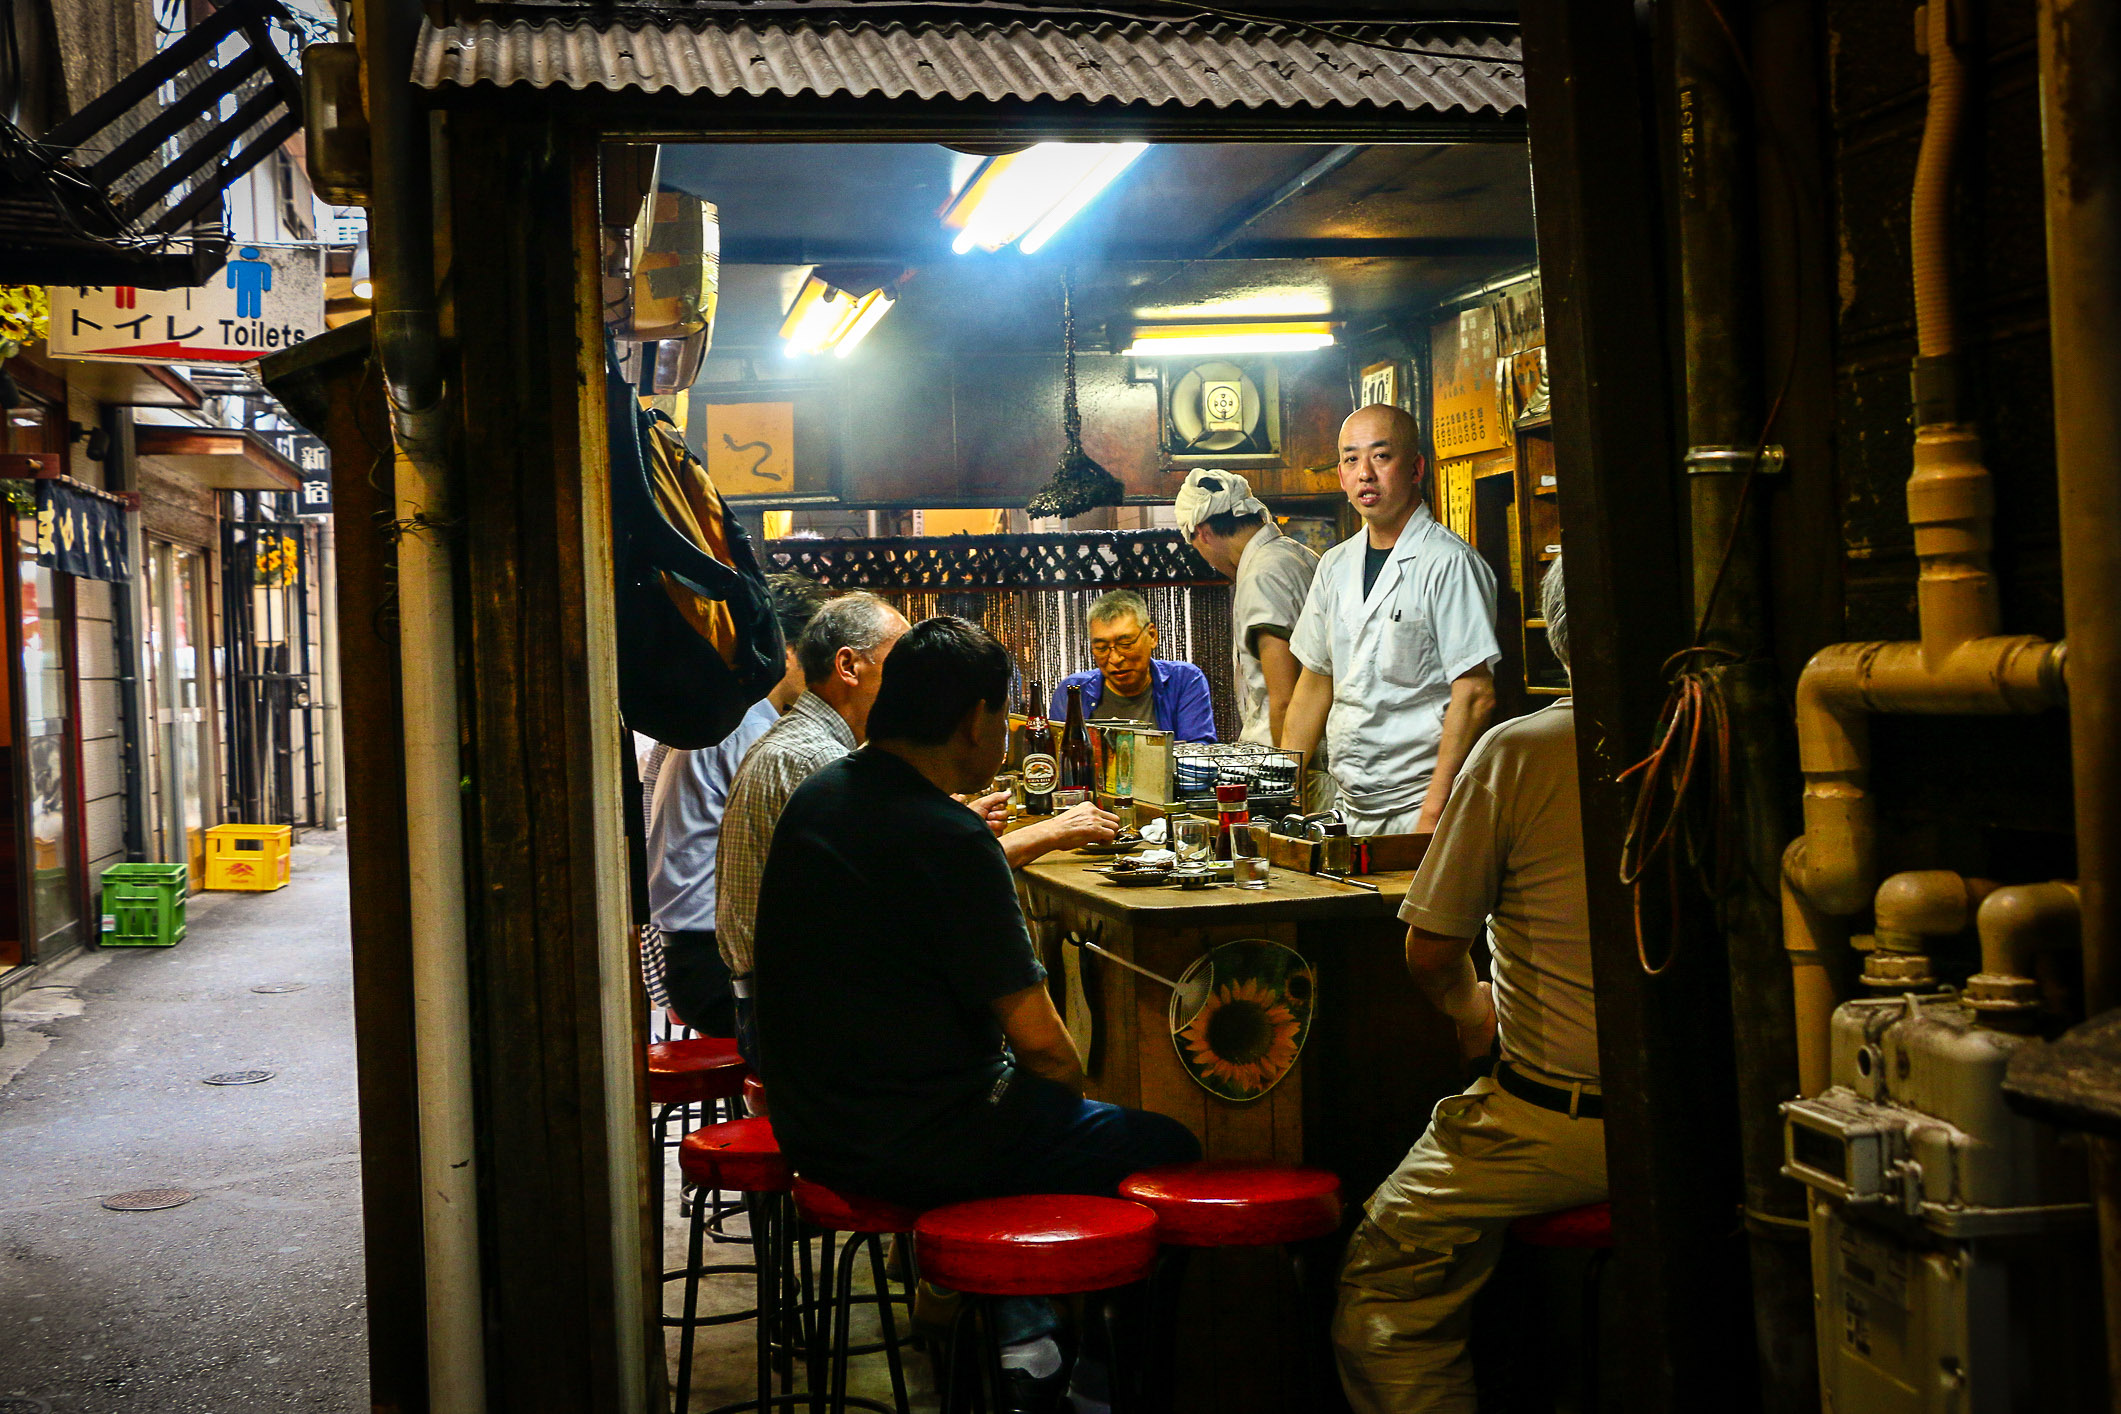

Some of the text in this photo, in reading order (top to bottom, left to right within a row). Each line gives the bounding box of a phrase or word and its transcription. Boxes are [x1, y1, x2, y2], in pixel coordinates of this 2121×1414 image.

[71, 309, 204, 341] トイレ
[219, 319, 305, 348] Toilets
[301, 446, 329, 504] 新宿
